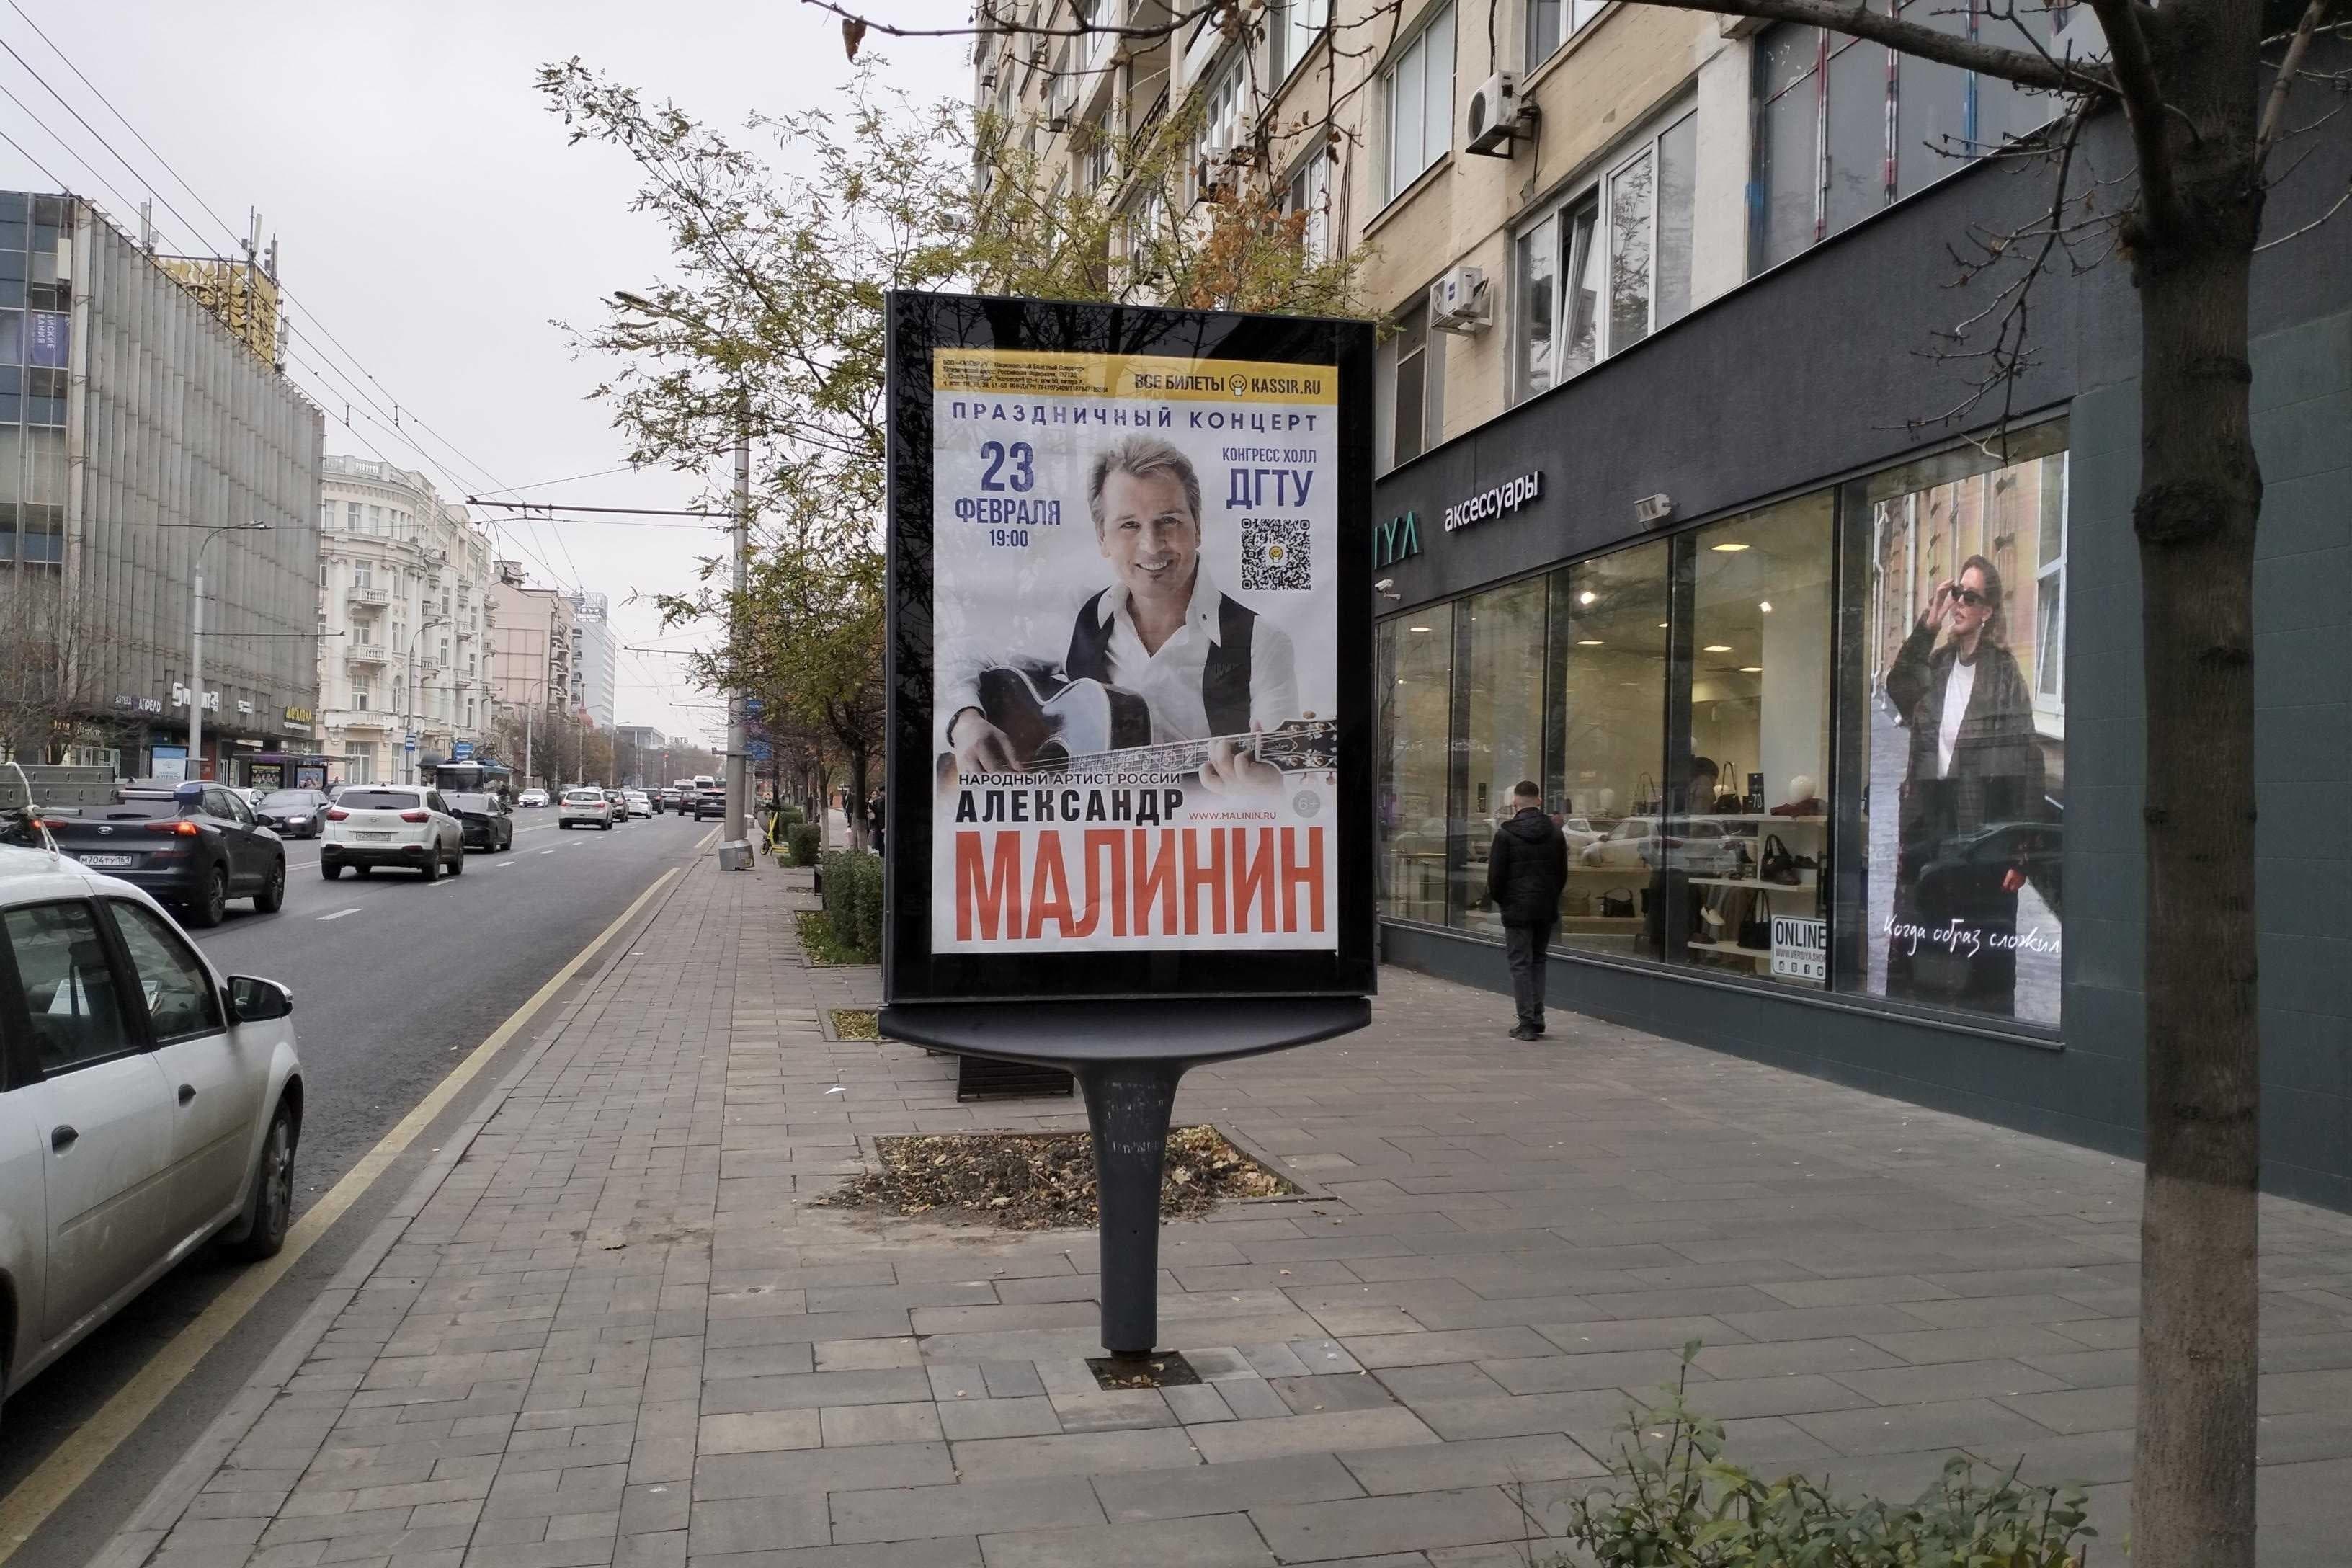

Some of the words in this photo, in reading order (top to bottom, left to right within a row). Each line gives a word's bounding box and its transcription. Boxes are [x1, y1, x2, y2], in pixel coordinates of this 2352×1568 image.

[1135, 374, 1162, 389] ВСЕ
[1165, 375, 1225, 391] БИЛЕТЫ
[1251, 378, 1321, 395] KASSIR.RU
[952, 401, 1172, 427] ПРАЗДНИЧНЫЙ
[1190, 411, 1317, 433] КОНЦЕРТ
[980, 441, 1034, 493] 23
[1222, 447, 1280, 463] КОНГРЕСС
[1283, 449, 1317, 463] ХОЛЛ
[1226, 468, 1314, 509] ДГТУ
[1445, 471, 1538, 532] аксессуары
[956, 497, 1061, 525] ФЕВРАЛЯ
[989, 530, 1028, 547] 19:00
[958, 771, 1048, 787] НАРОДНЫЙ
[1054, 772, 1113, 786] АРТИСТ
[1118, 772, 1180, 785] РОССИИ
[956, 788, 1183, 826] АЛЕКСАНДР
[1189, 811, 1276, 821] WWW.MALININ.RU
[1298, 797, 1319, 810] 6+
[956, 827, 1325, 941] МАЛИНИН
[1776, 921, 1827, 950] ONLINE
[1884, 913, 1925, 956] Когда
[1933, 918, 1981, 958] образ
